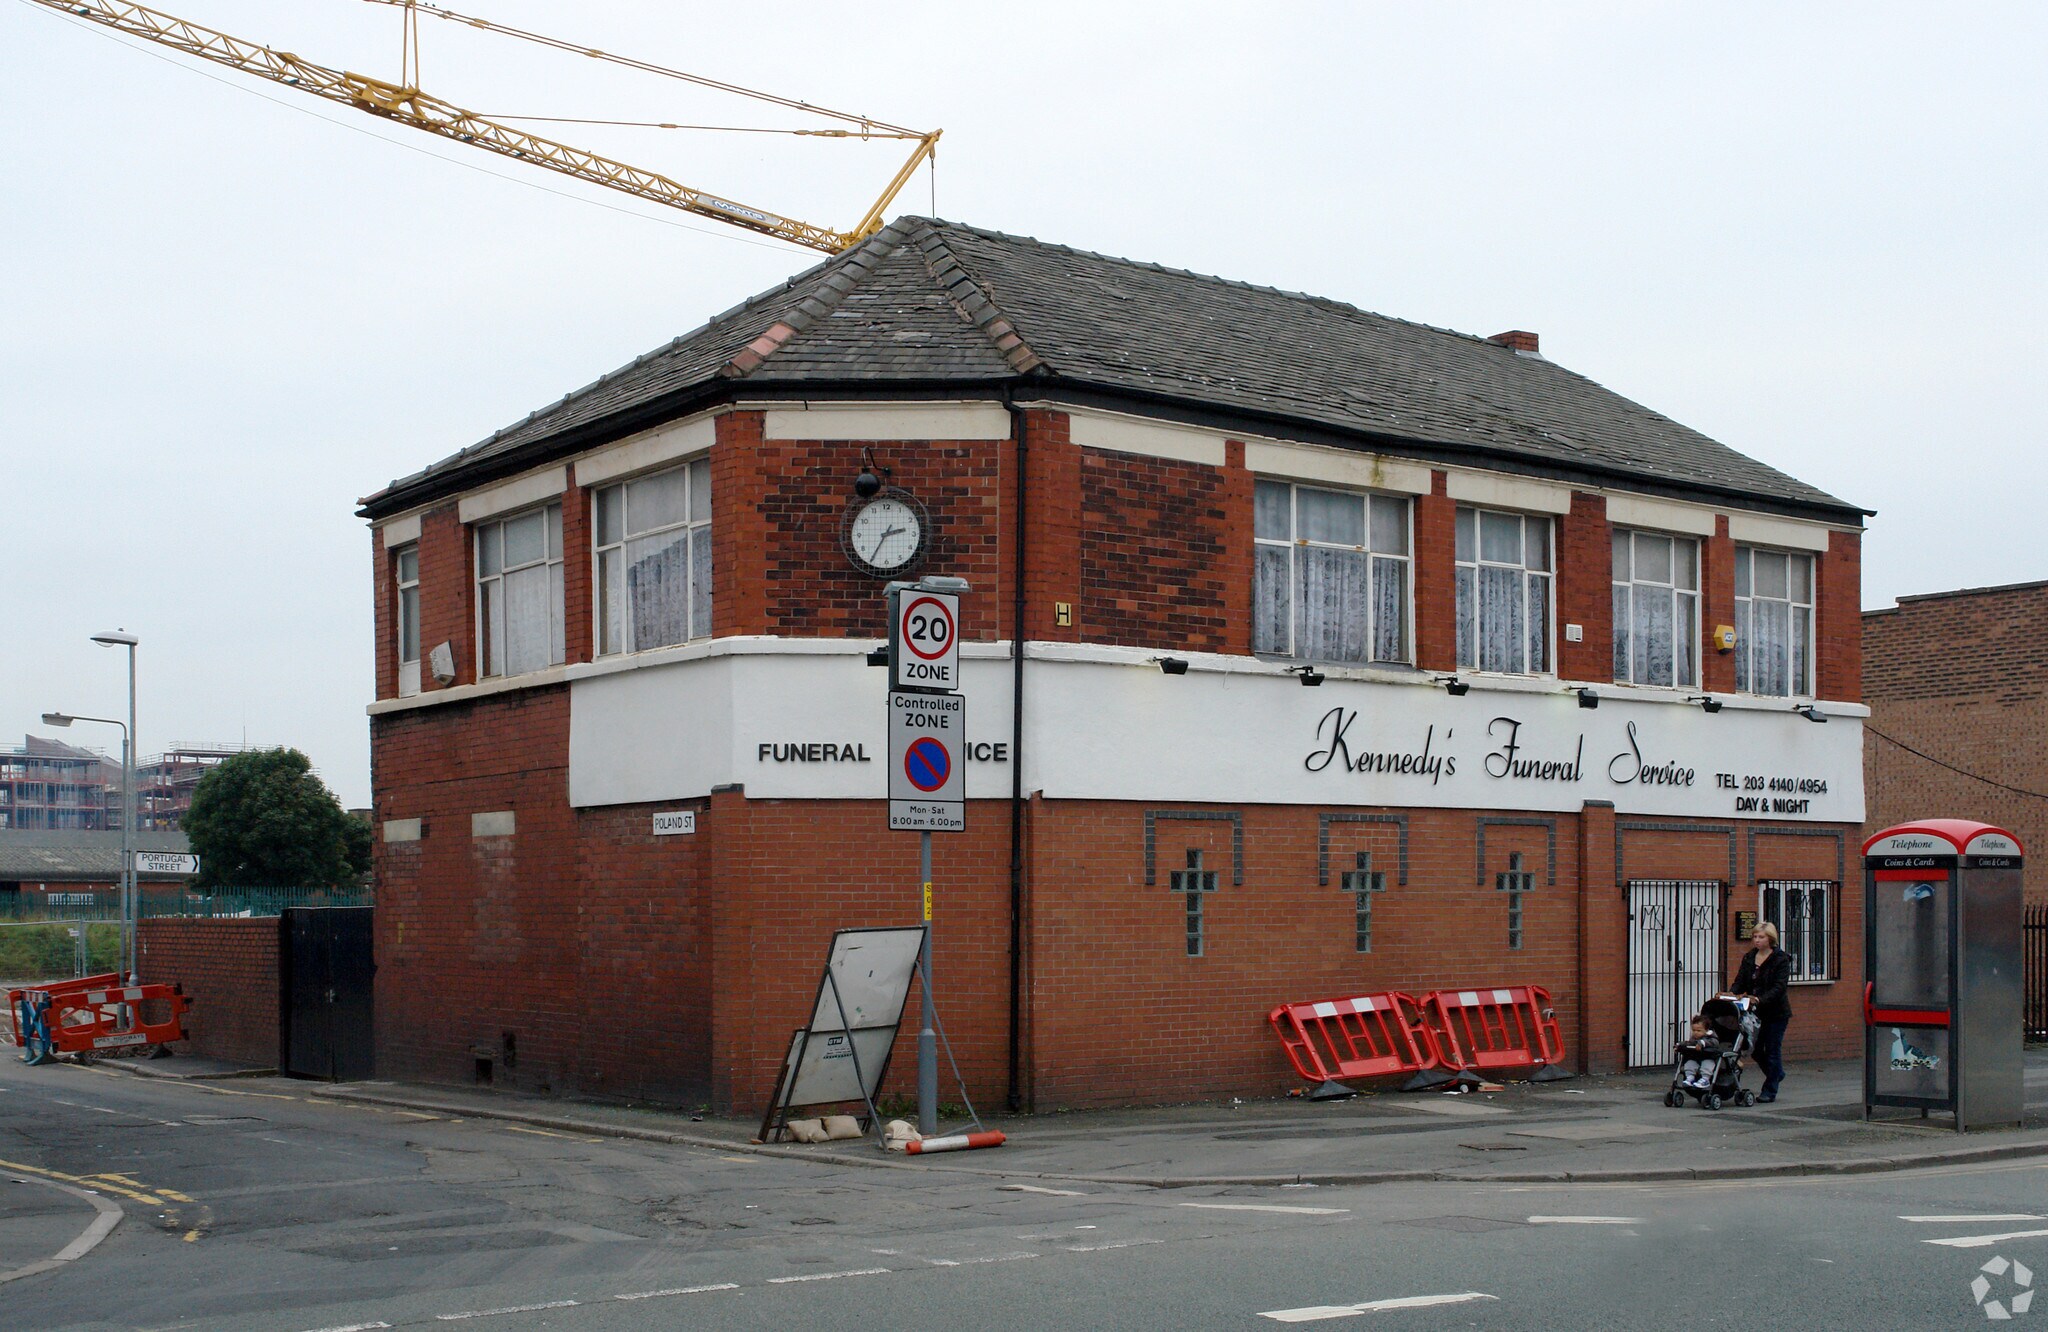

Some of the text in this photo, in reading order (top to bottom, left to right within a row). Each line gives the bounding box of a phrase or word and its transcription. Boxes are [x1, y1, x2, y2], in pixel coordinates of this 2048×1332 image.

[1057, 604, 1069, 623] H
[912, 615, 947, 642] 20
[907, 663, 949, 680] ZONE
[895, 696, 959, 711] Controlled
[905, 713, 949, 728] ZONE
[758, 743, 871, 762] FUNERAL
[1305, 707, 1695, 786] Kennedy's Funeral Service
[1716, 773, 1828, 794] TEL 203 4140/4954
[1736, 797, 1810, 813] DAY & NIGHT
[655, 816, 692, 829] POLAND ST
[1891, 840, 1933, 850] Telephone
[1981, 839, 2006, 850] Telephone
[142, 854, 188, 863] PORTUGAL
[1914, 858, 1934, 866] Cards
[1979, 858, 2010, 866] Coins & Cards
[149, 863, 181, 871] STREET
